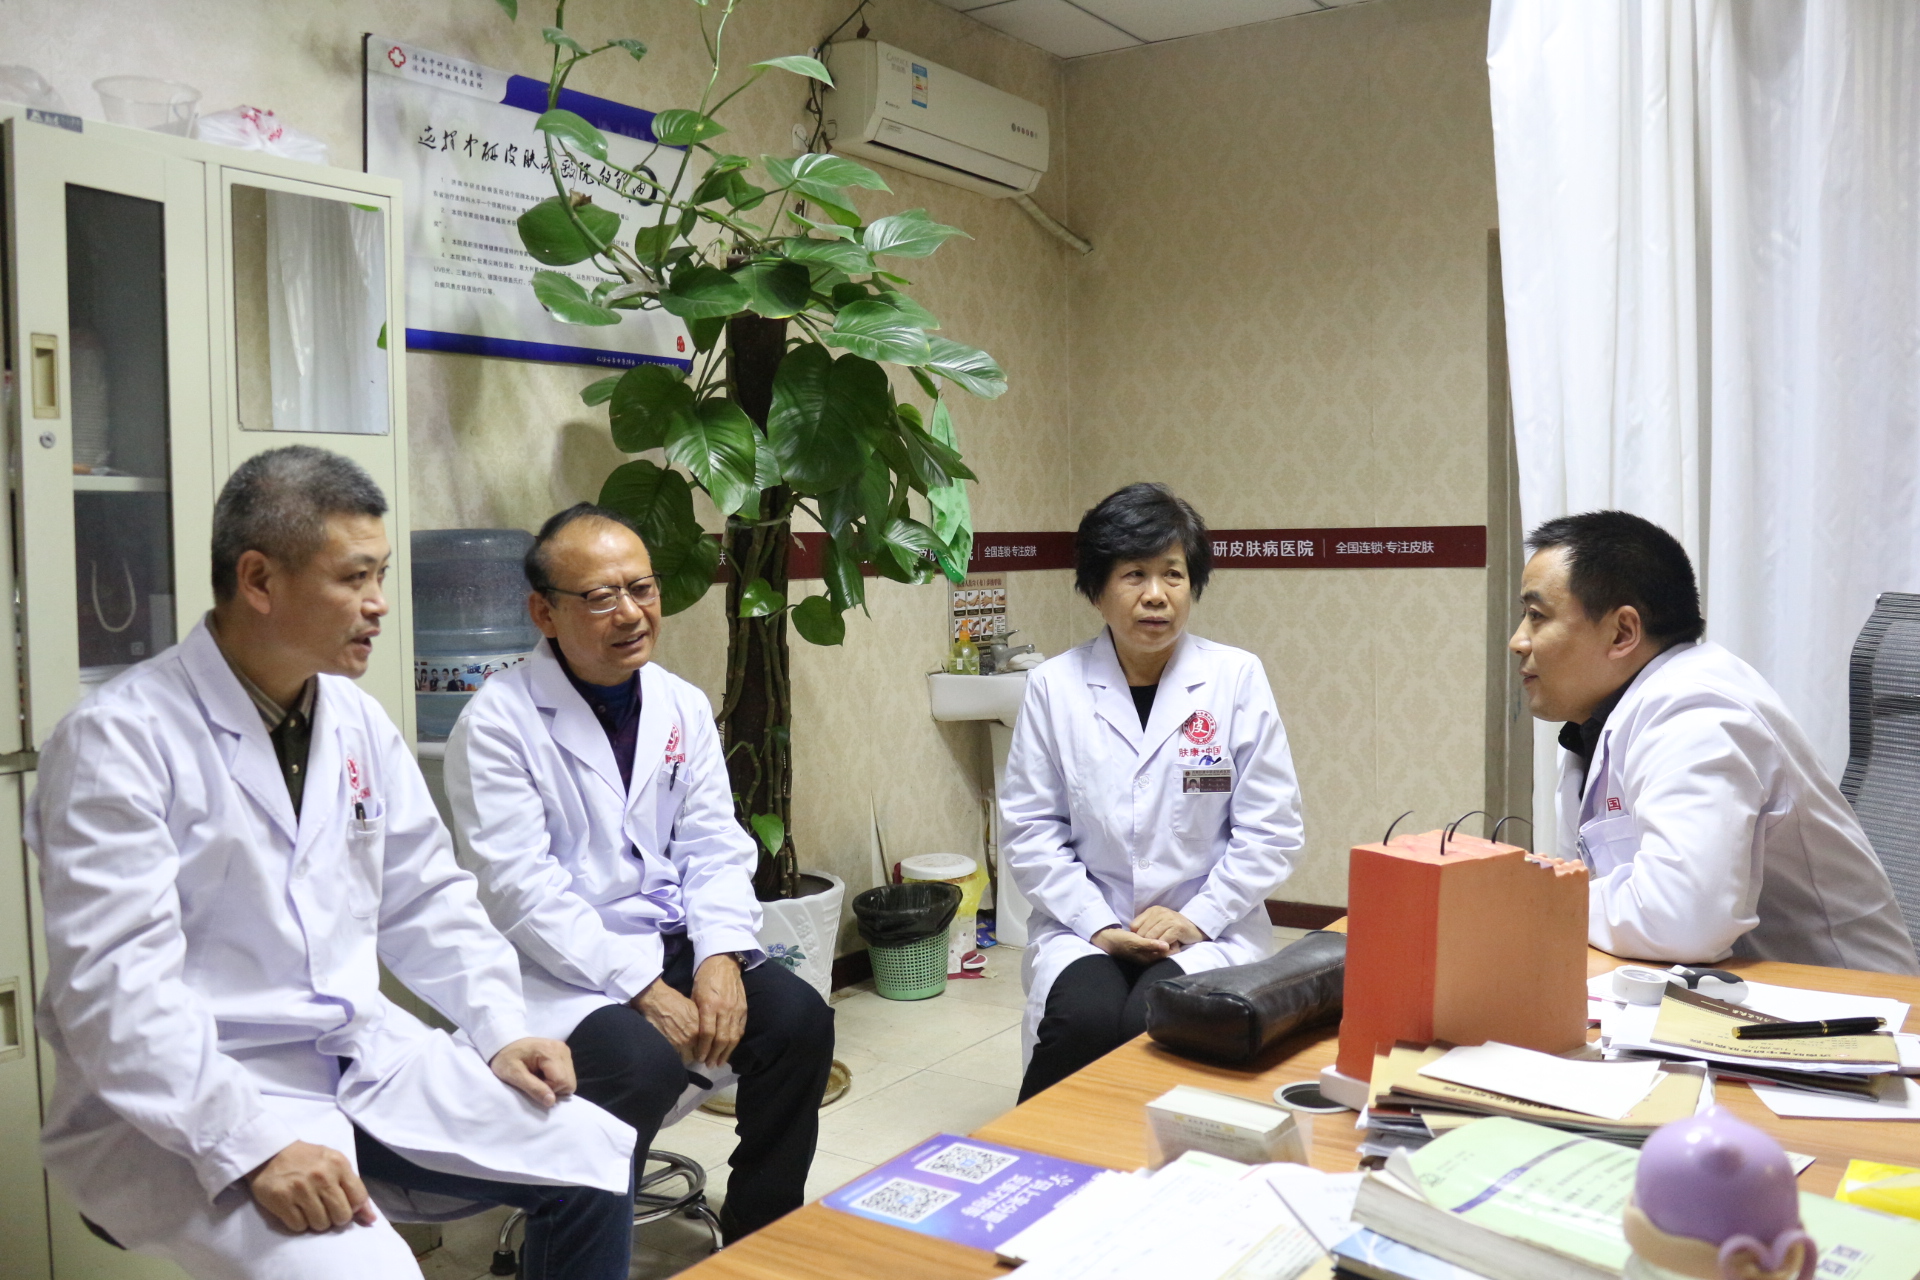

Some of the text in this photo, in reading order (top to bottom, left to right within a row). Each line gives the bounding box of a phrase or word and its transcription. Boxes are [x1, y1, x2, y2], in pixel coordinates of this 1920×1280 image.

[1212, 539, 1435, 558] 研皮肤病医院 全国连锁·专注皮肤
